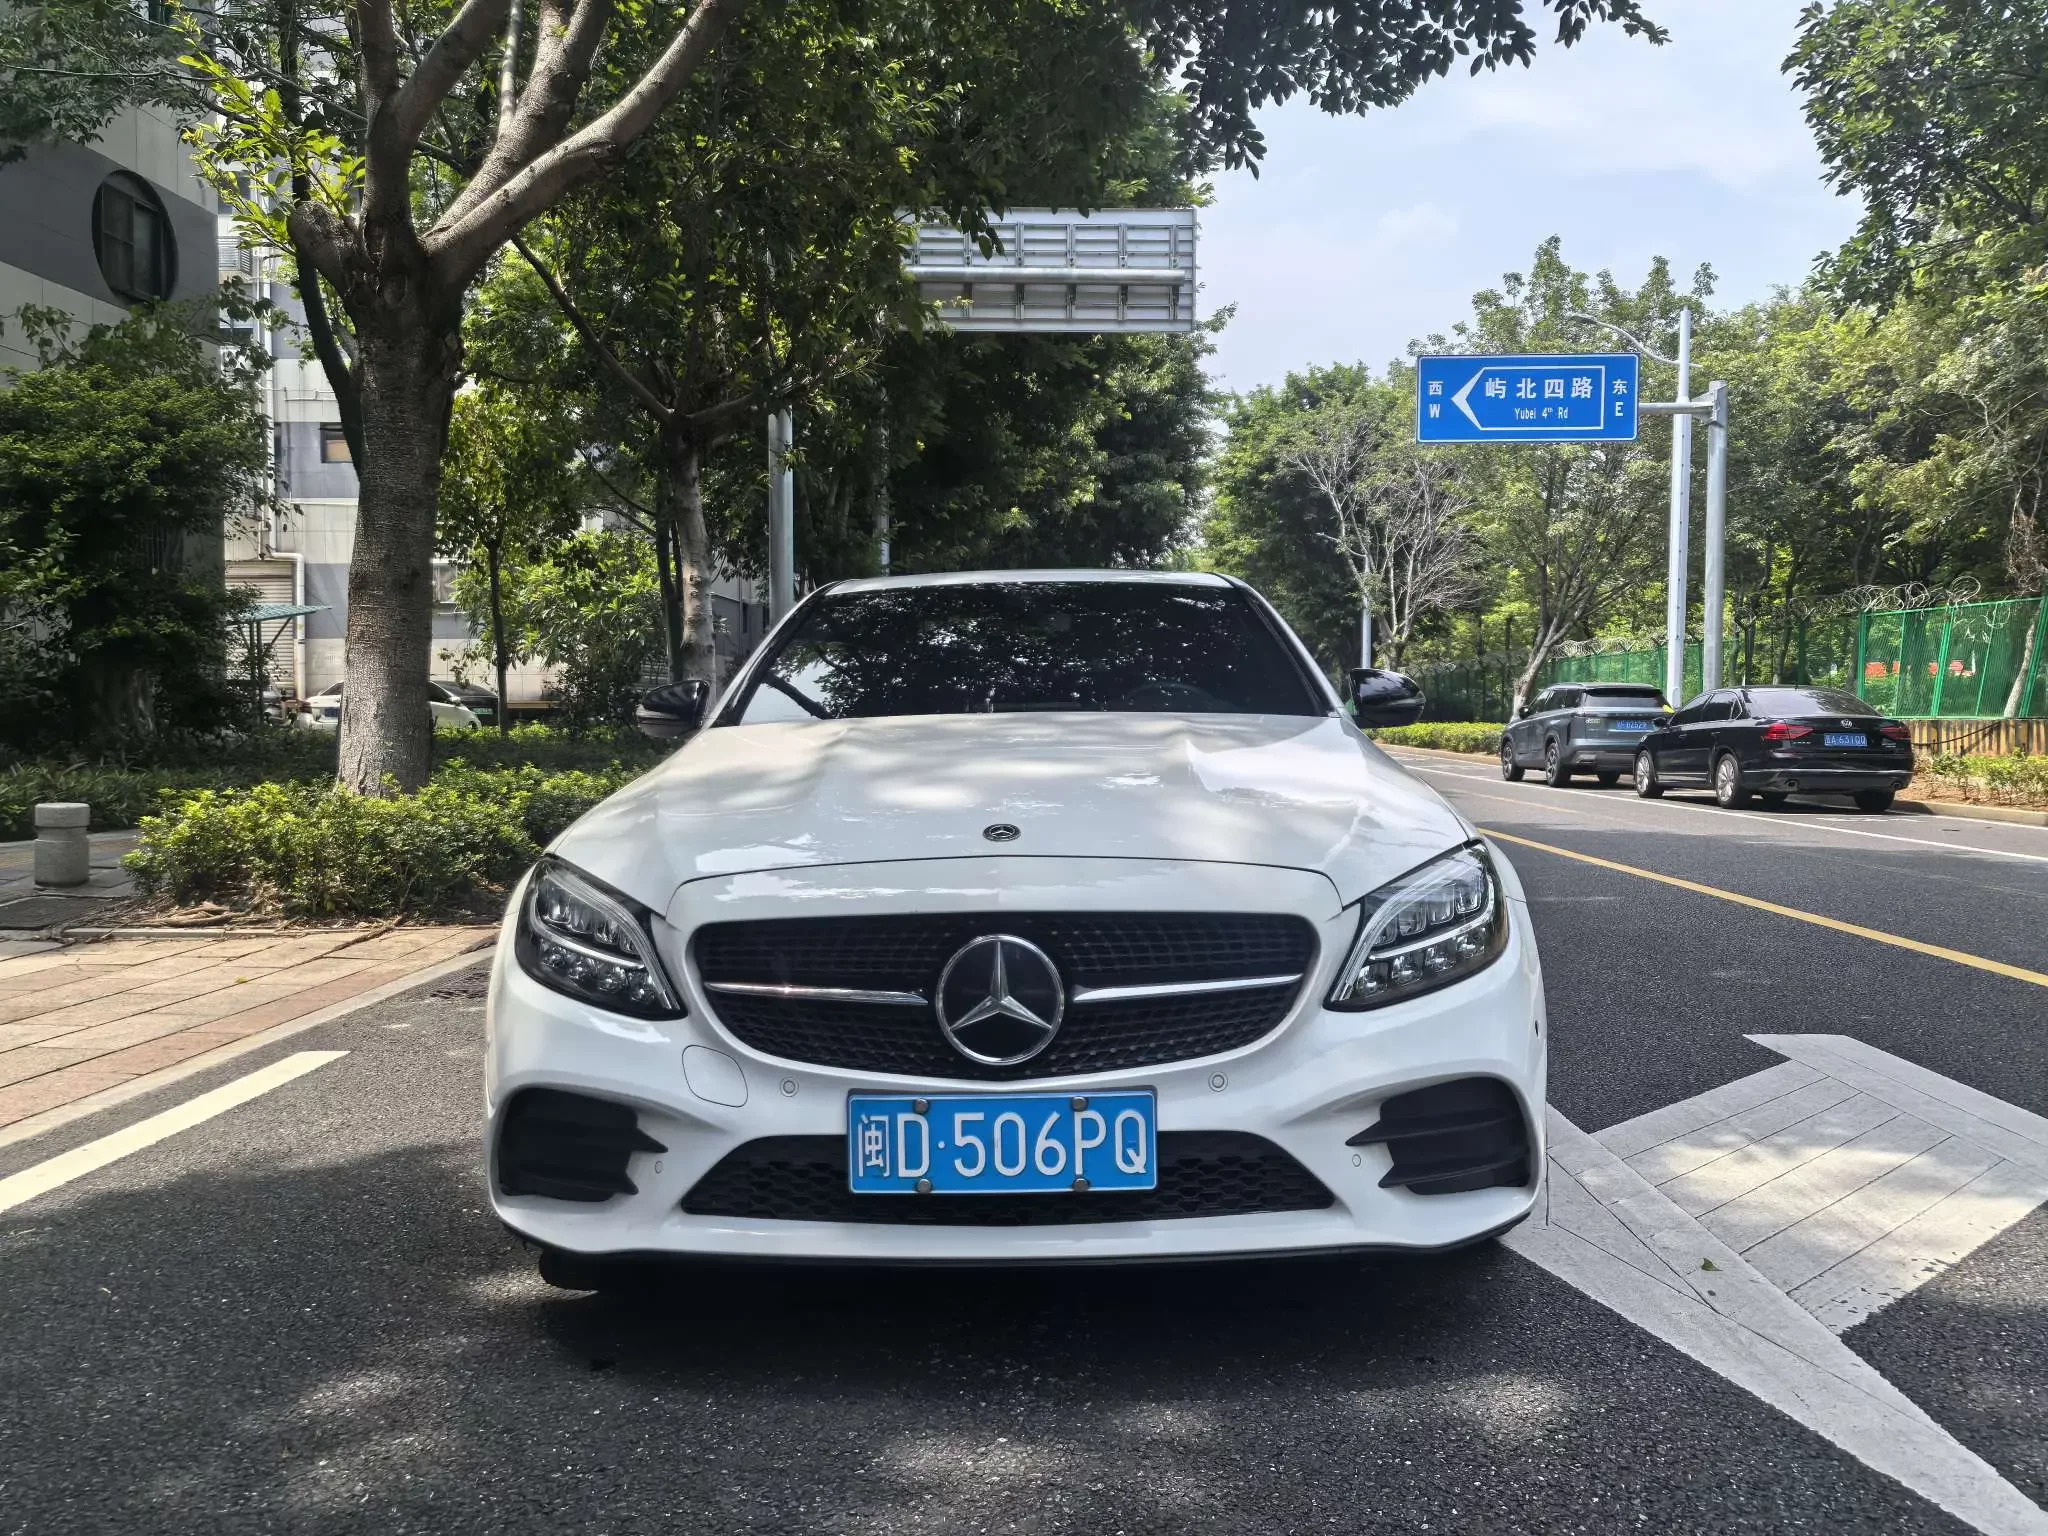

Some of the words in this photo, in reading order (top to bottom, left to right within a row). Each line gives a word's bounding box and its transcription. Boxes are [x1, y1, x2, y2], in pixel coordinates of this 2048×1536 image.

[1427, 381, 1444, 396] 西
[1485, 376, 1593, 399] 屿北四路
[1612, 379, 1628, 395] 东
[1429, 403, 1441, 418] W
[1514, 407, 1537, 420] Yubei
[1558, 407, 1569, 420] Rd
[1615, 402, 1624, 417] E
[857, 1109, 1148, 1178] 闽D·506PQ
